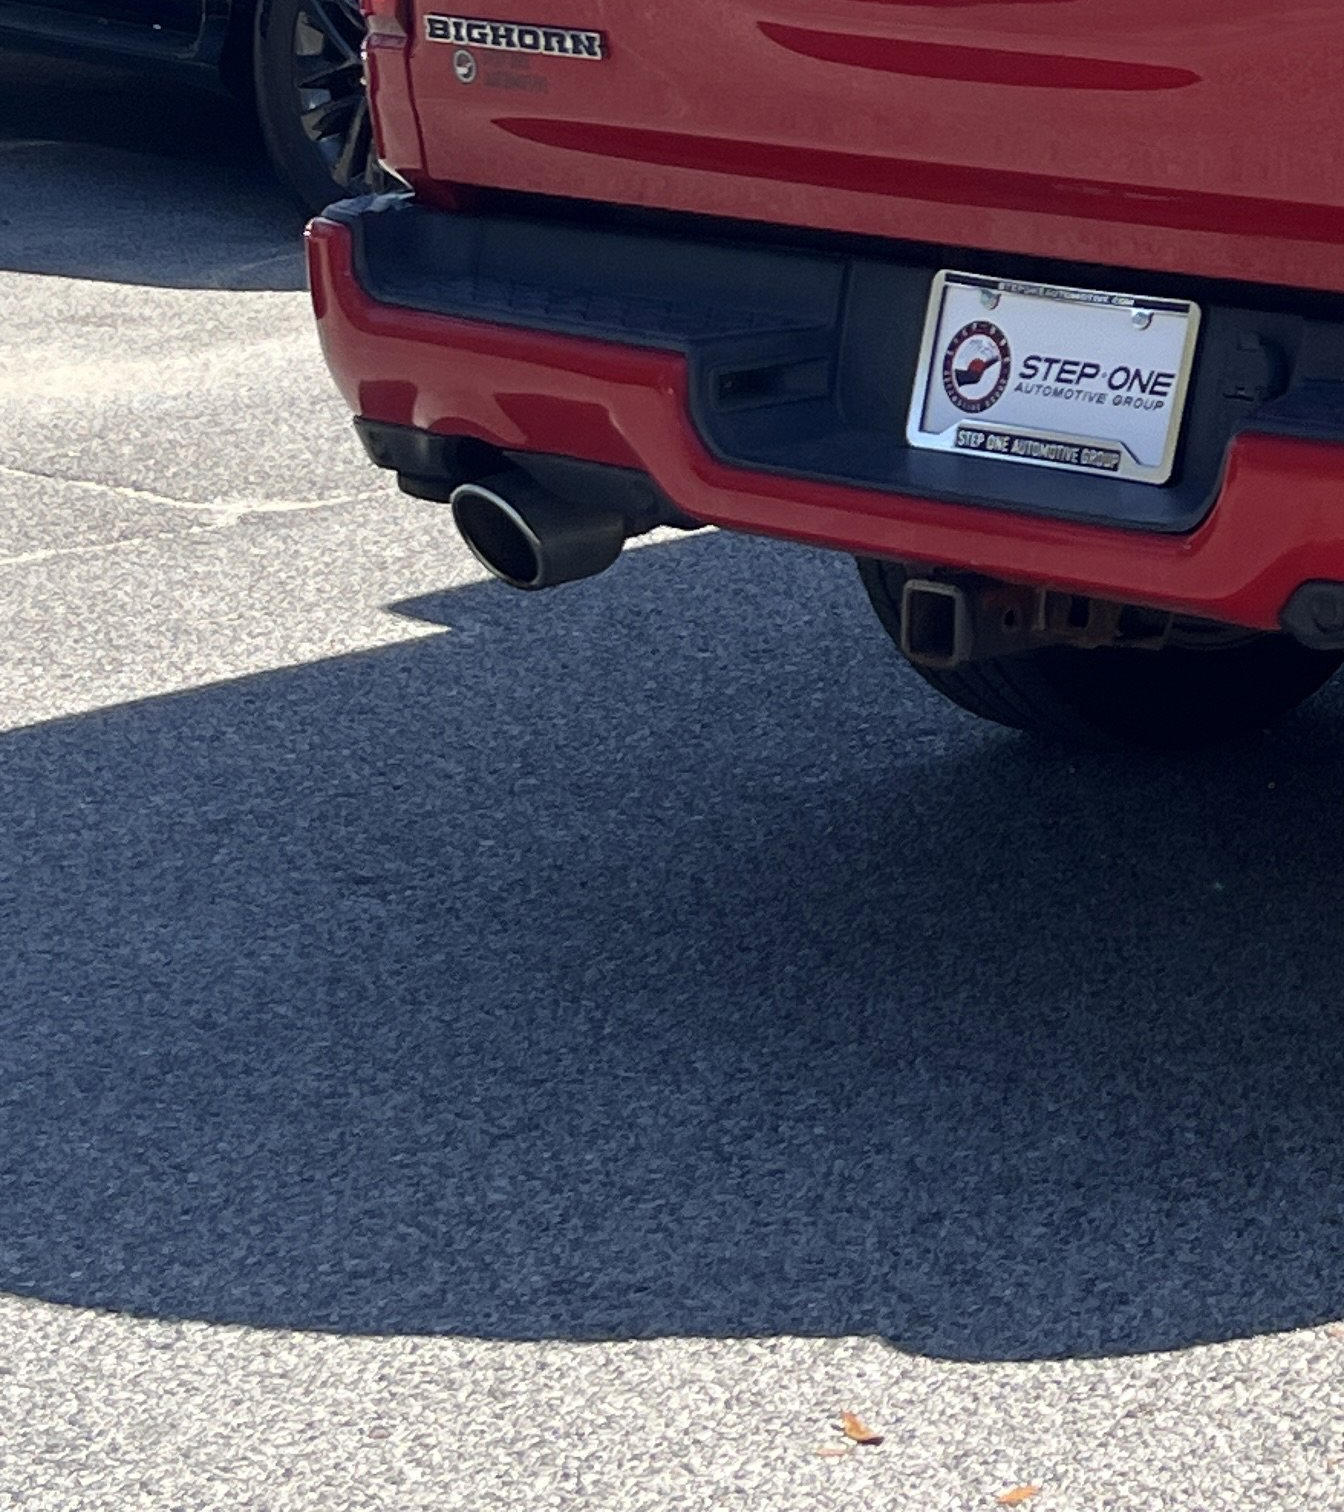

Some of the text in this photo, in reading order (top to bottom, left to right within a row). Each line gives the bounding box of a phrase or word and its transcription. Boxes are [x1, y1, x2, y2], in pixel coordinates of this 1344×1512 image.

[424, 14, 603, 60] BIGHORN
[1013, 382, 1165, 411] AUTOMOTIVE GROUP
[957, 429, 1120, 469] STEP ONE AUTOMOTIVE GROUP
